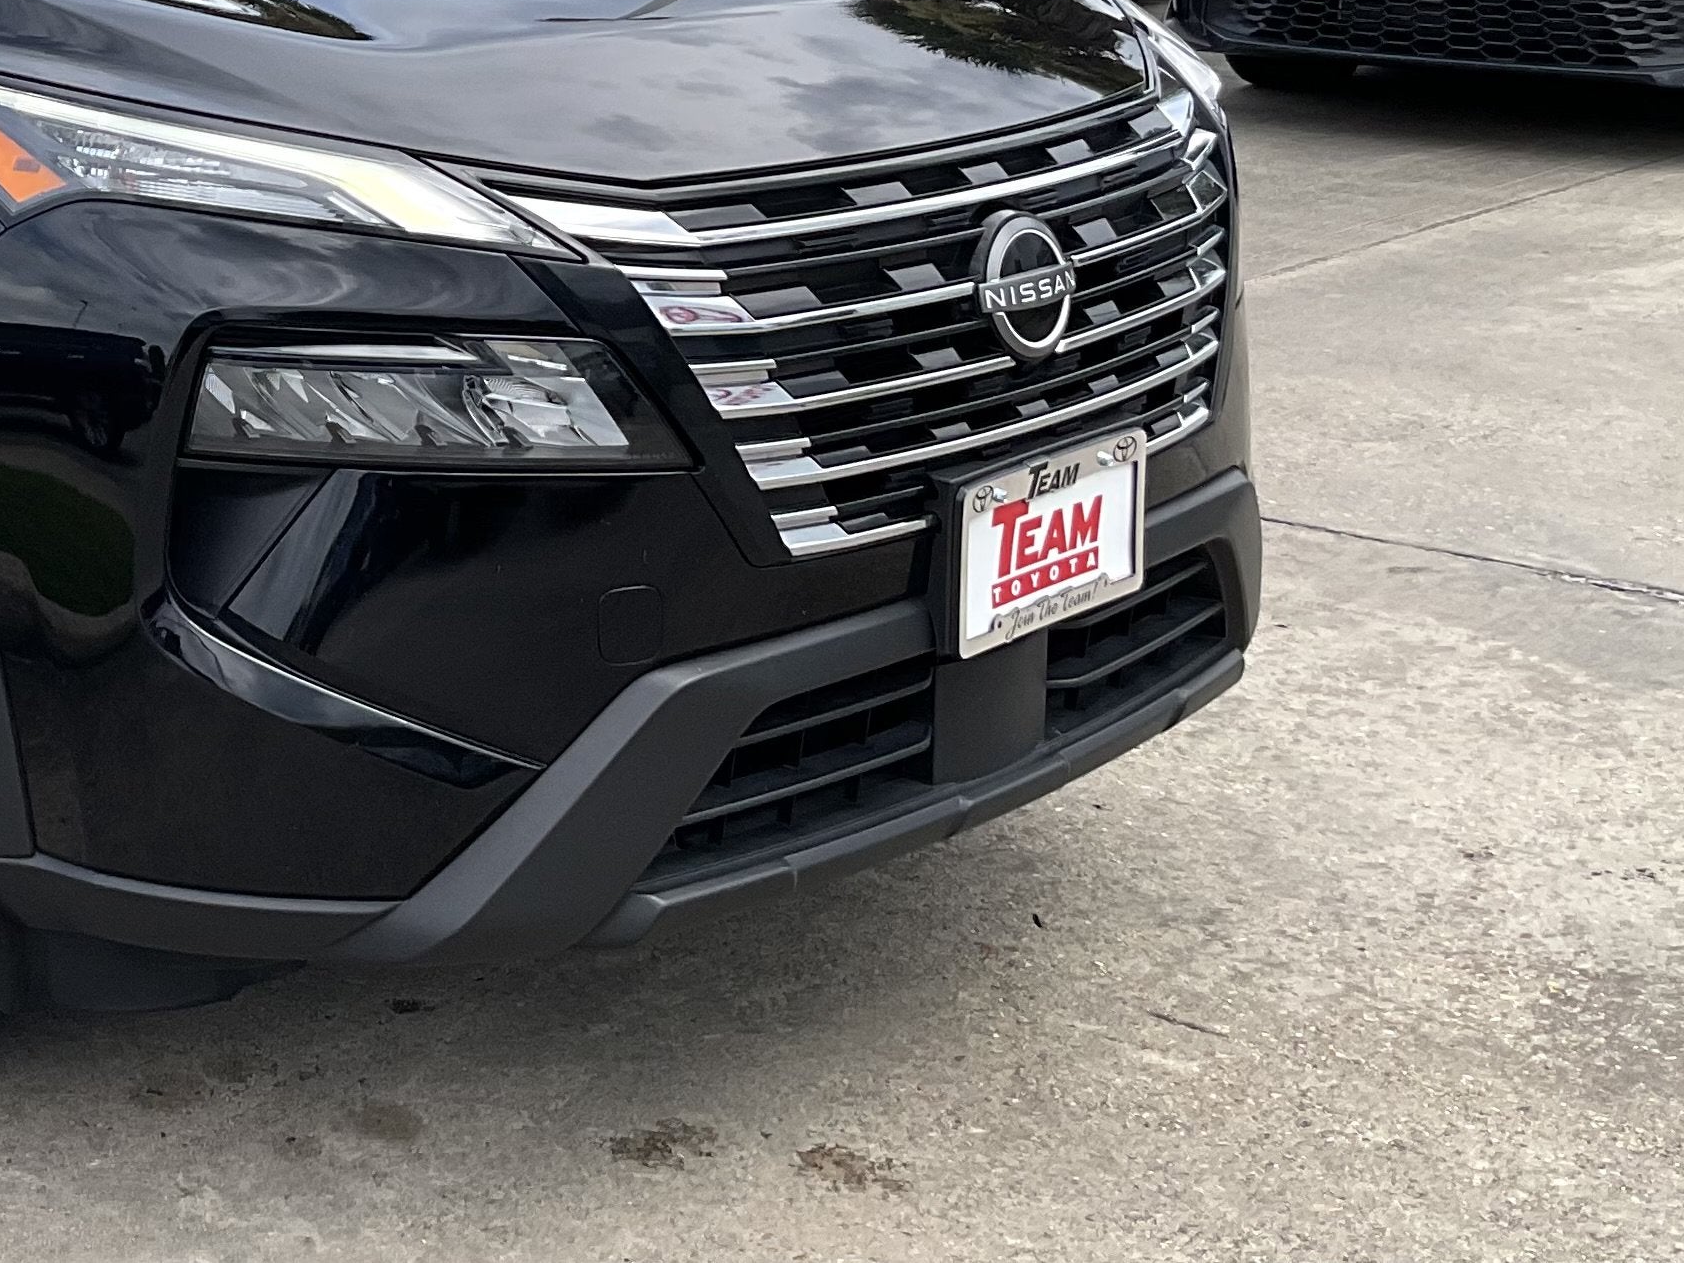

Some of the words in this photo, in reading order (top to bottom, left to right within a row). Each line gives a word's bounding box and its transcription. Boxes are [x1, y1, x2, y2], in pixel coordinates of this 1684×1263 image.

[984, 270, 1076, 309] NISSAN
[1026, 461, 1080, 500] TEAM
[991, 494, 1103, 579] TEAM
[993, 552, 1096, 604] TOYOTA
[1005, 608, 1035, 640] Join
[1036, 597, 1059, 621] The
[1060, 581, 1099, 611] Team!
